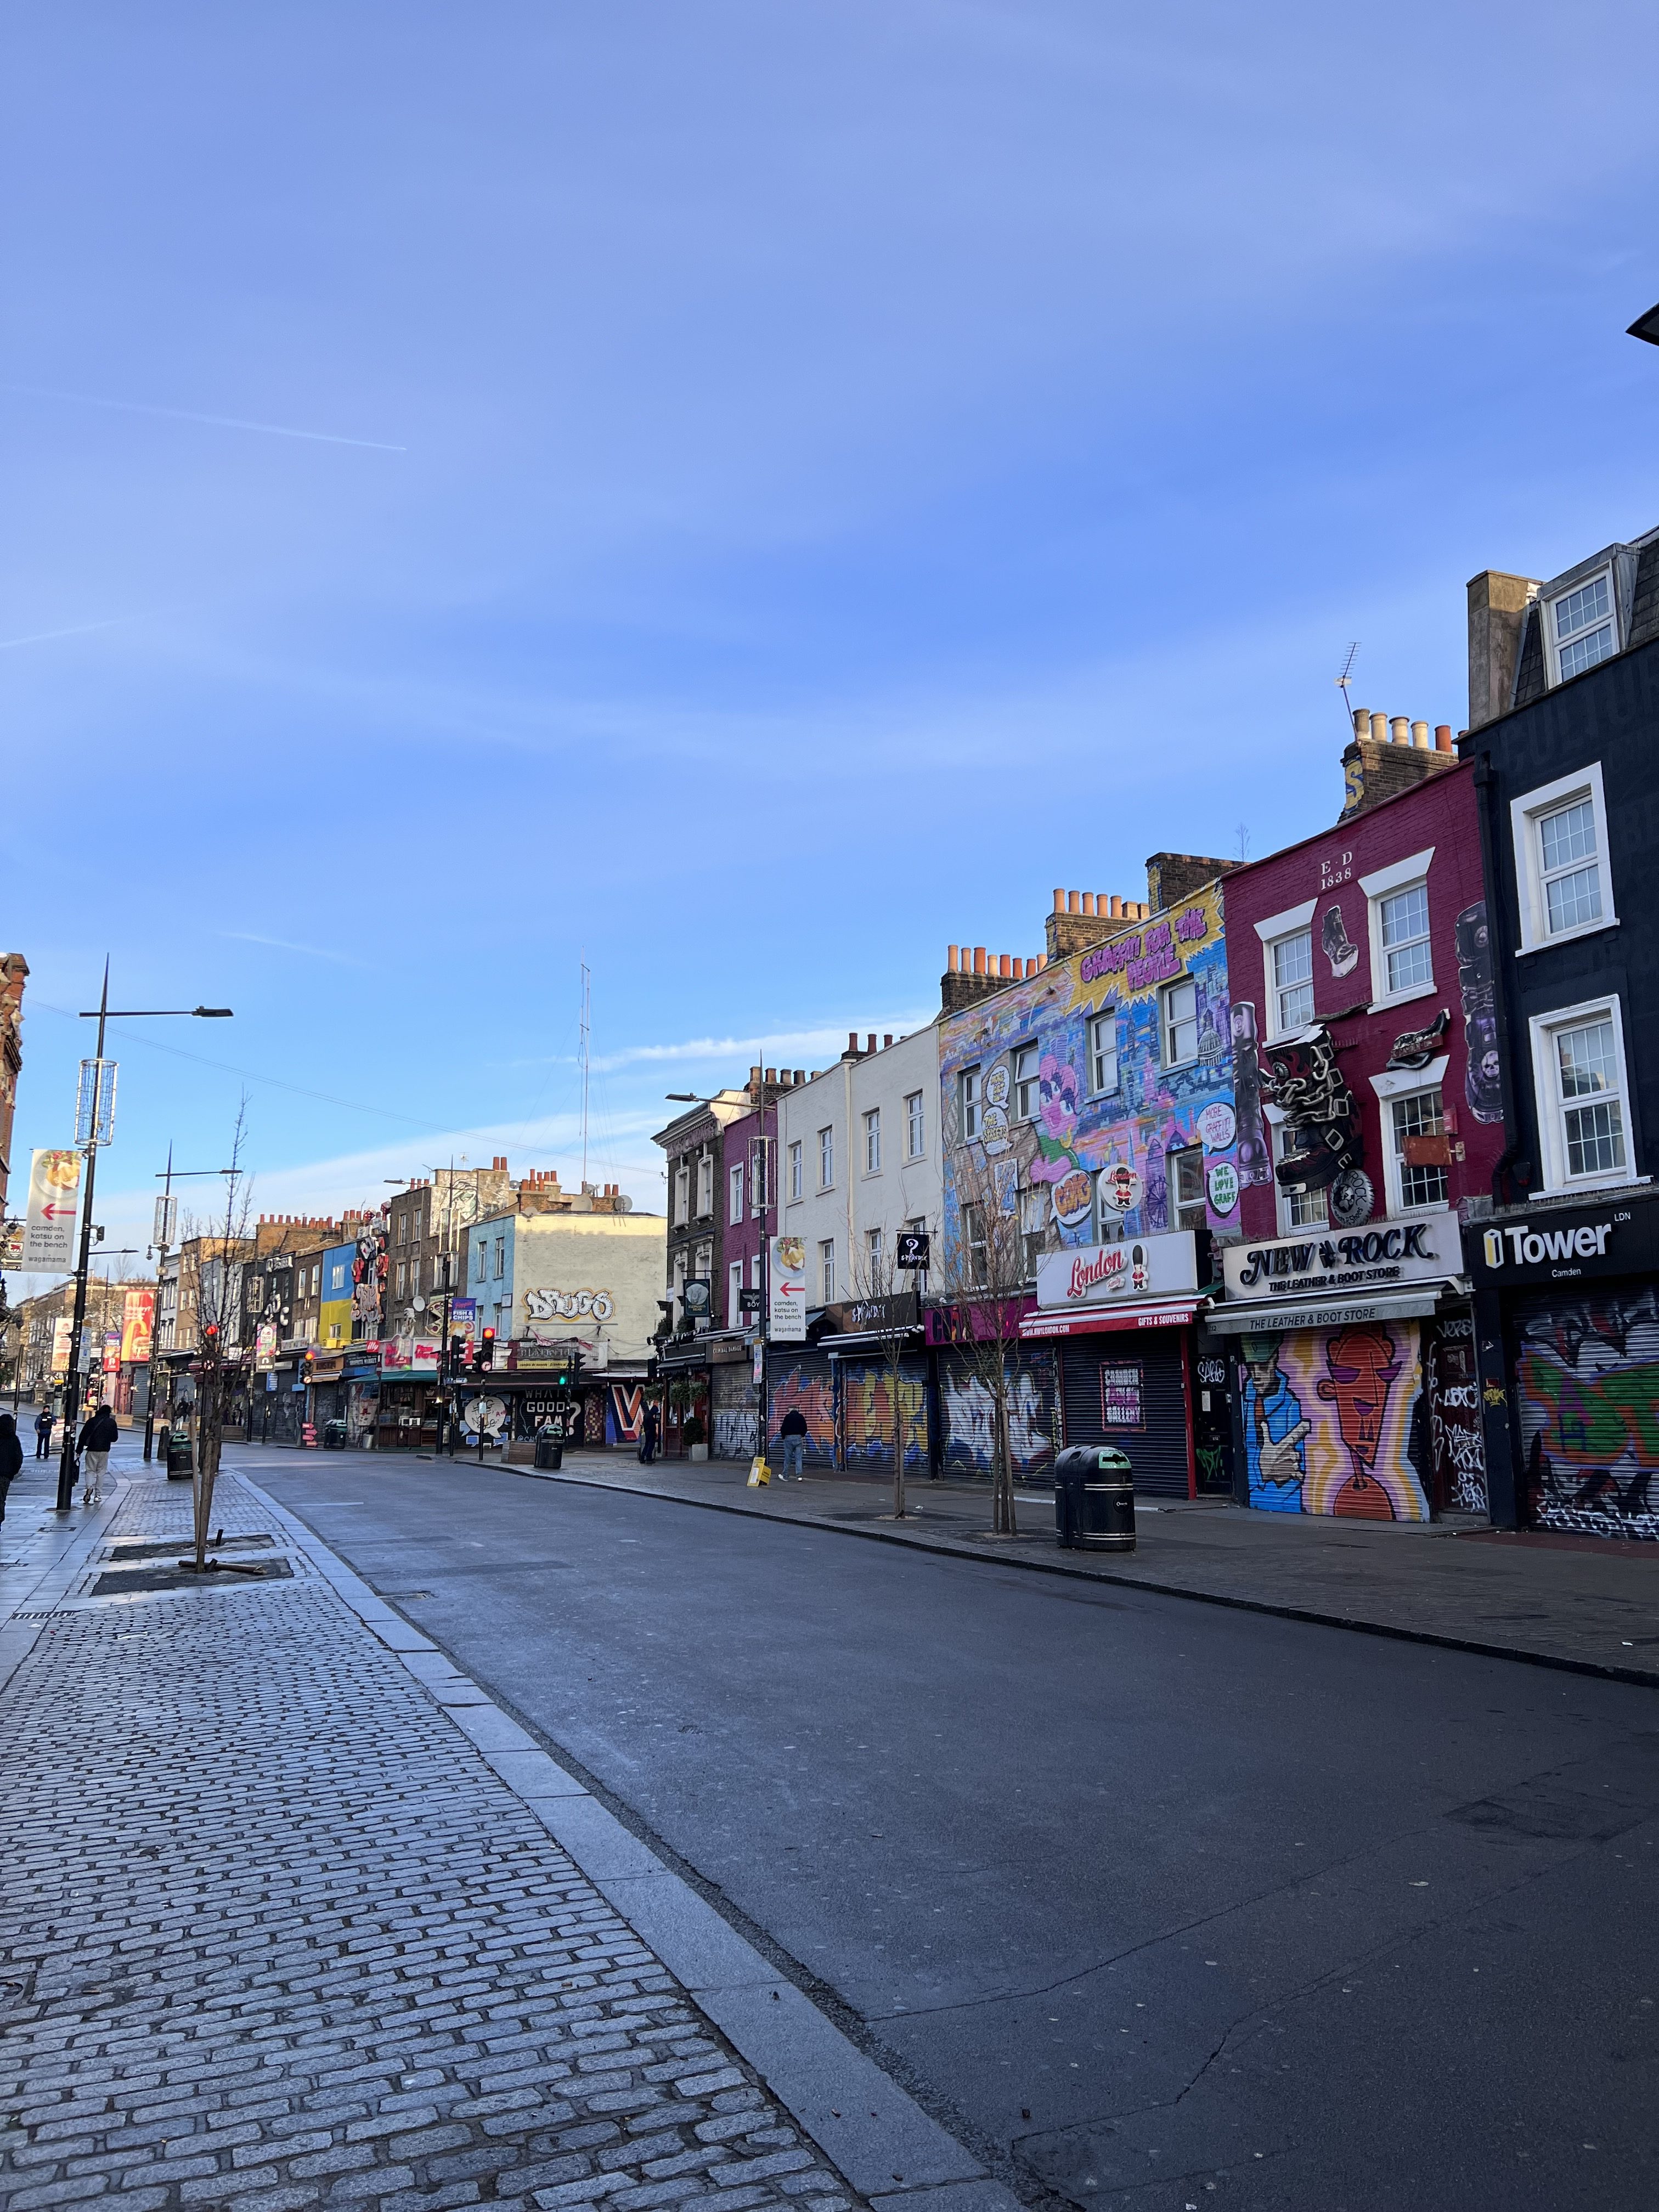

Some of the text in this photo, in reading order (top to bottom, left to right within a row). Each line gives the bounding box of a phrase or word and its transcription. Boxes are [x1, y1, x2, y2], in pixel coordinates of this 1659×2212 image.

[1321, 851, 1352, 875] E D
[1321, 867, 1352, 890] 1838
[1080, 907, 1207, 984] GRAFFITI FOR THE
[1126, 944, 1183, 992] PEOPLE
[984, 1113, 998, 1127] THE
[1205, 1105, 1222, 1120] MORE
[1205, 1117, 1232, 1133] GRAFFITI
[1210, 1130, 1231, 1143] WALLS
[1106, 1170, 1138, 1184] London
[1215, 1166, 1229, 1177] WE
[1215, 1177, 1234, 1192] LOVE
[1348, 1170, 1367, 1206] ROCK
[1214, 1192, 1235, 1206] GRAFF
[1614, 1212, 1631, 1222] LDN
[1504, 1223, 1612, 1265] Tower
[1239, 1223, 1434, 1286] NEW ROCK
[1066, 1248, 1126, 1299] London
[1268, 1266, 1401, 1291] THE LEATHER & BOOT STORE
[1551, 1268, 1582, 1278] Camden
[524, 1289, 613, 1322] DRUGS
[1138, 1313, 1189, 1327] GIFTS & SOUVENIRS
[1250, 1308, 1376, 1330] THE LEATHER & BOOT STORE
[366, 1340, 379, 1352] illy
[527, 1402, 566, 1413] GOOD
[534, 1415, 563, 1427] FAM
